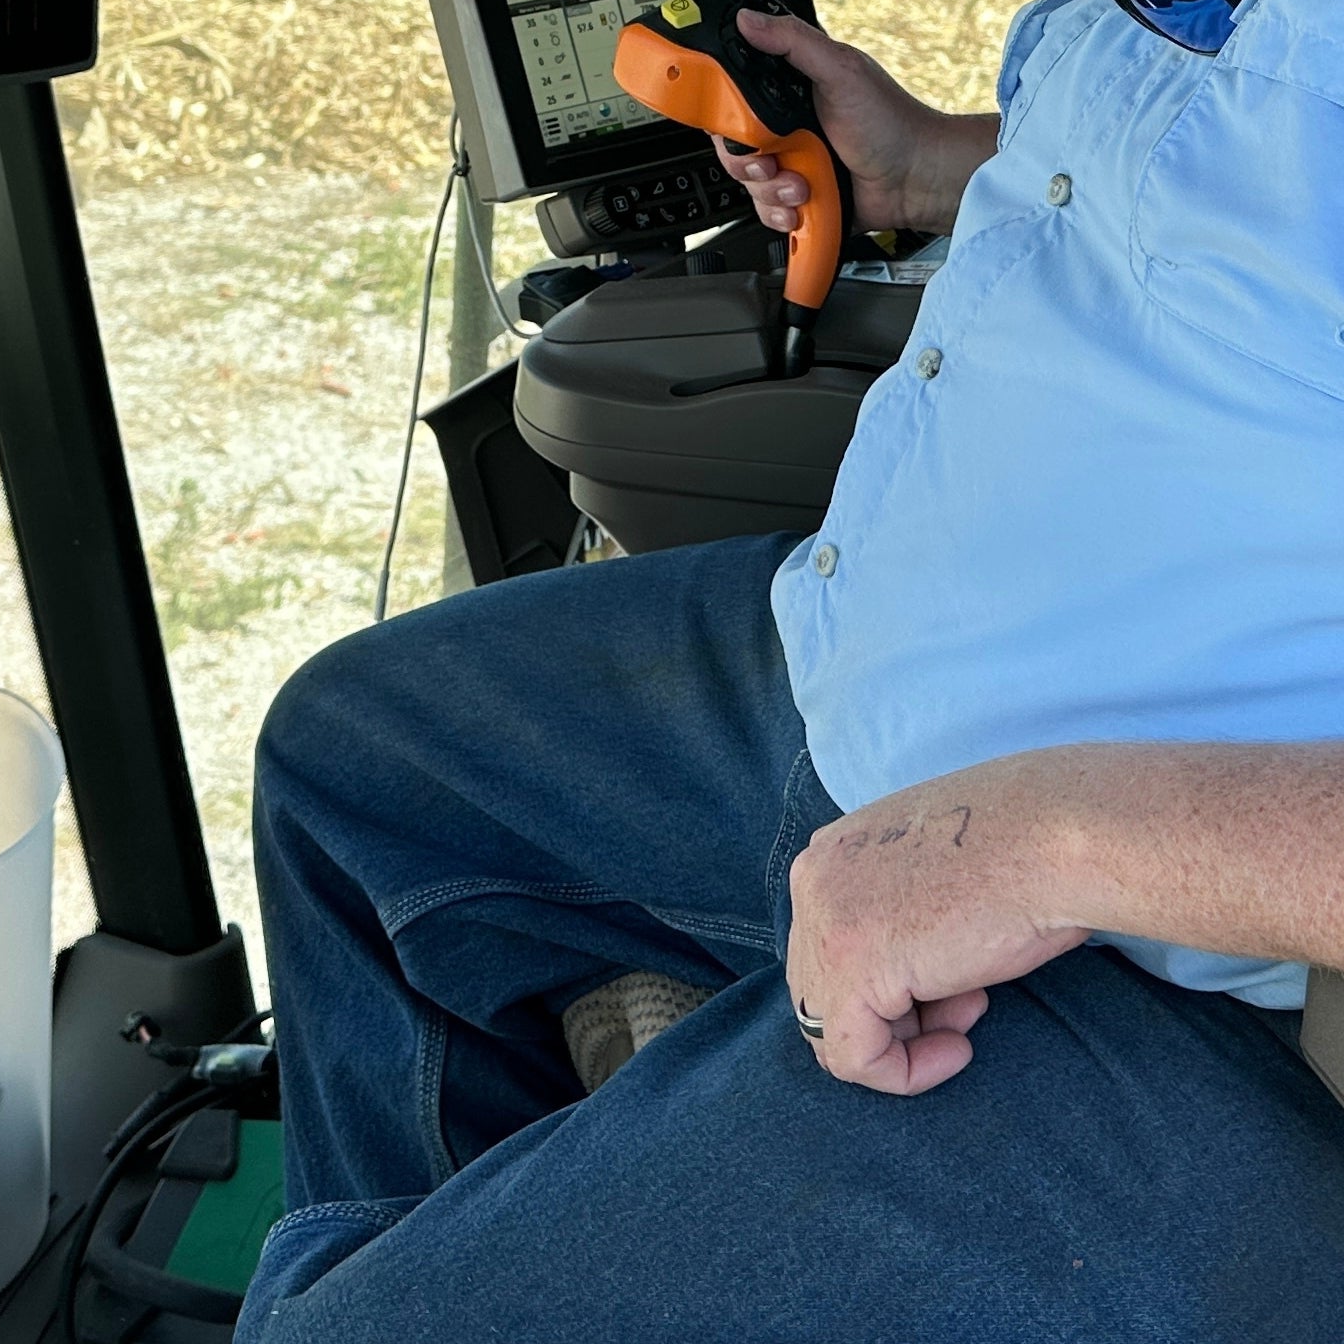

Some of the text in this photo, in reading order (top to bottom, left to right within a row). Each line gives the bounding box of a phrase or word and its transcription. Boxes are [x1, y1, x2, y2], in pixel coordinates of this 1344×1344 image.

[576, 21, 594, 34] 57.6
[541, 75, 552, 87] 24
[545, 94, 557, 106] 25
